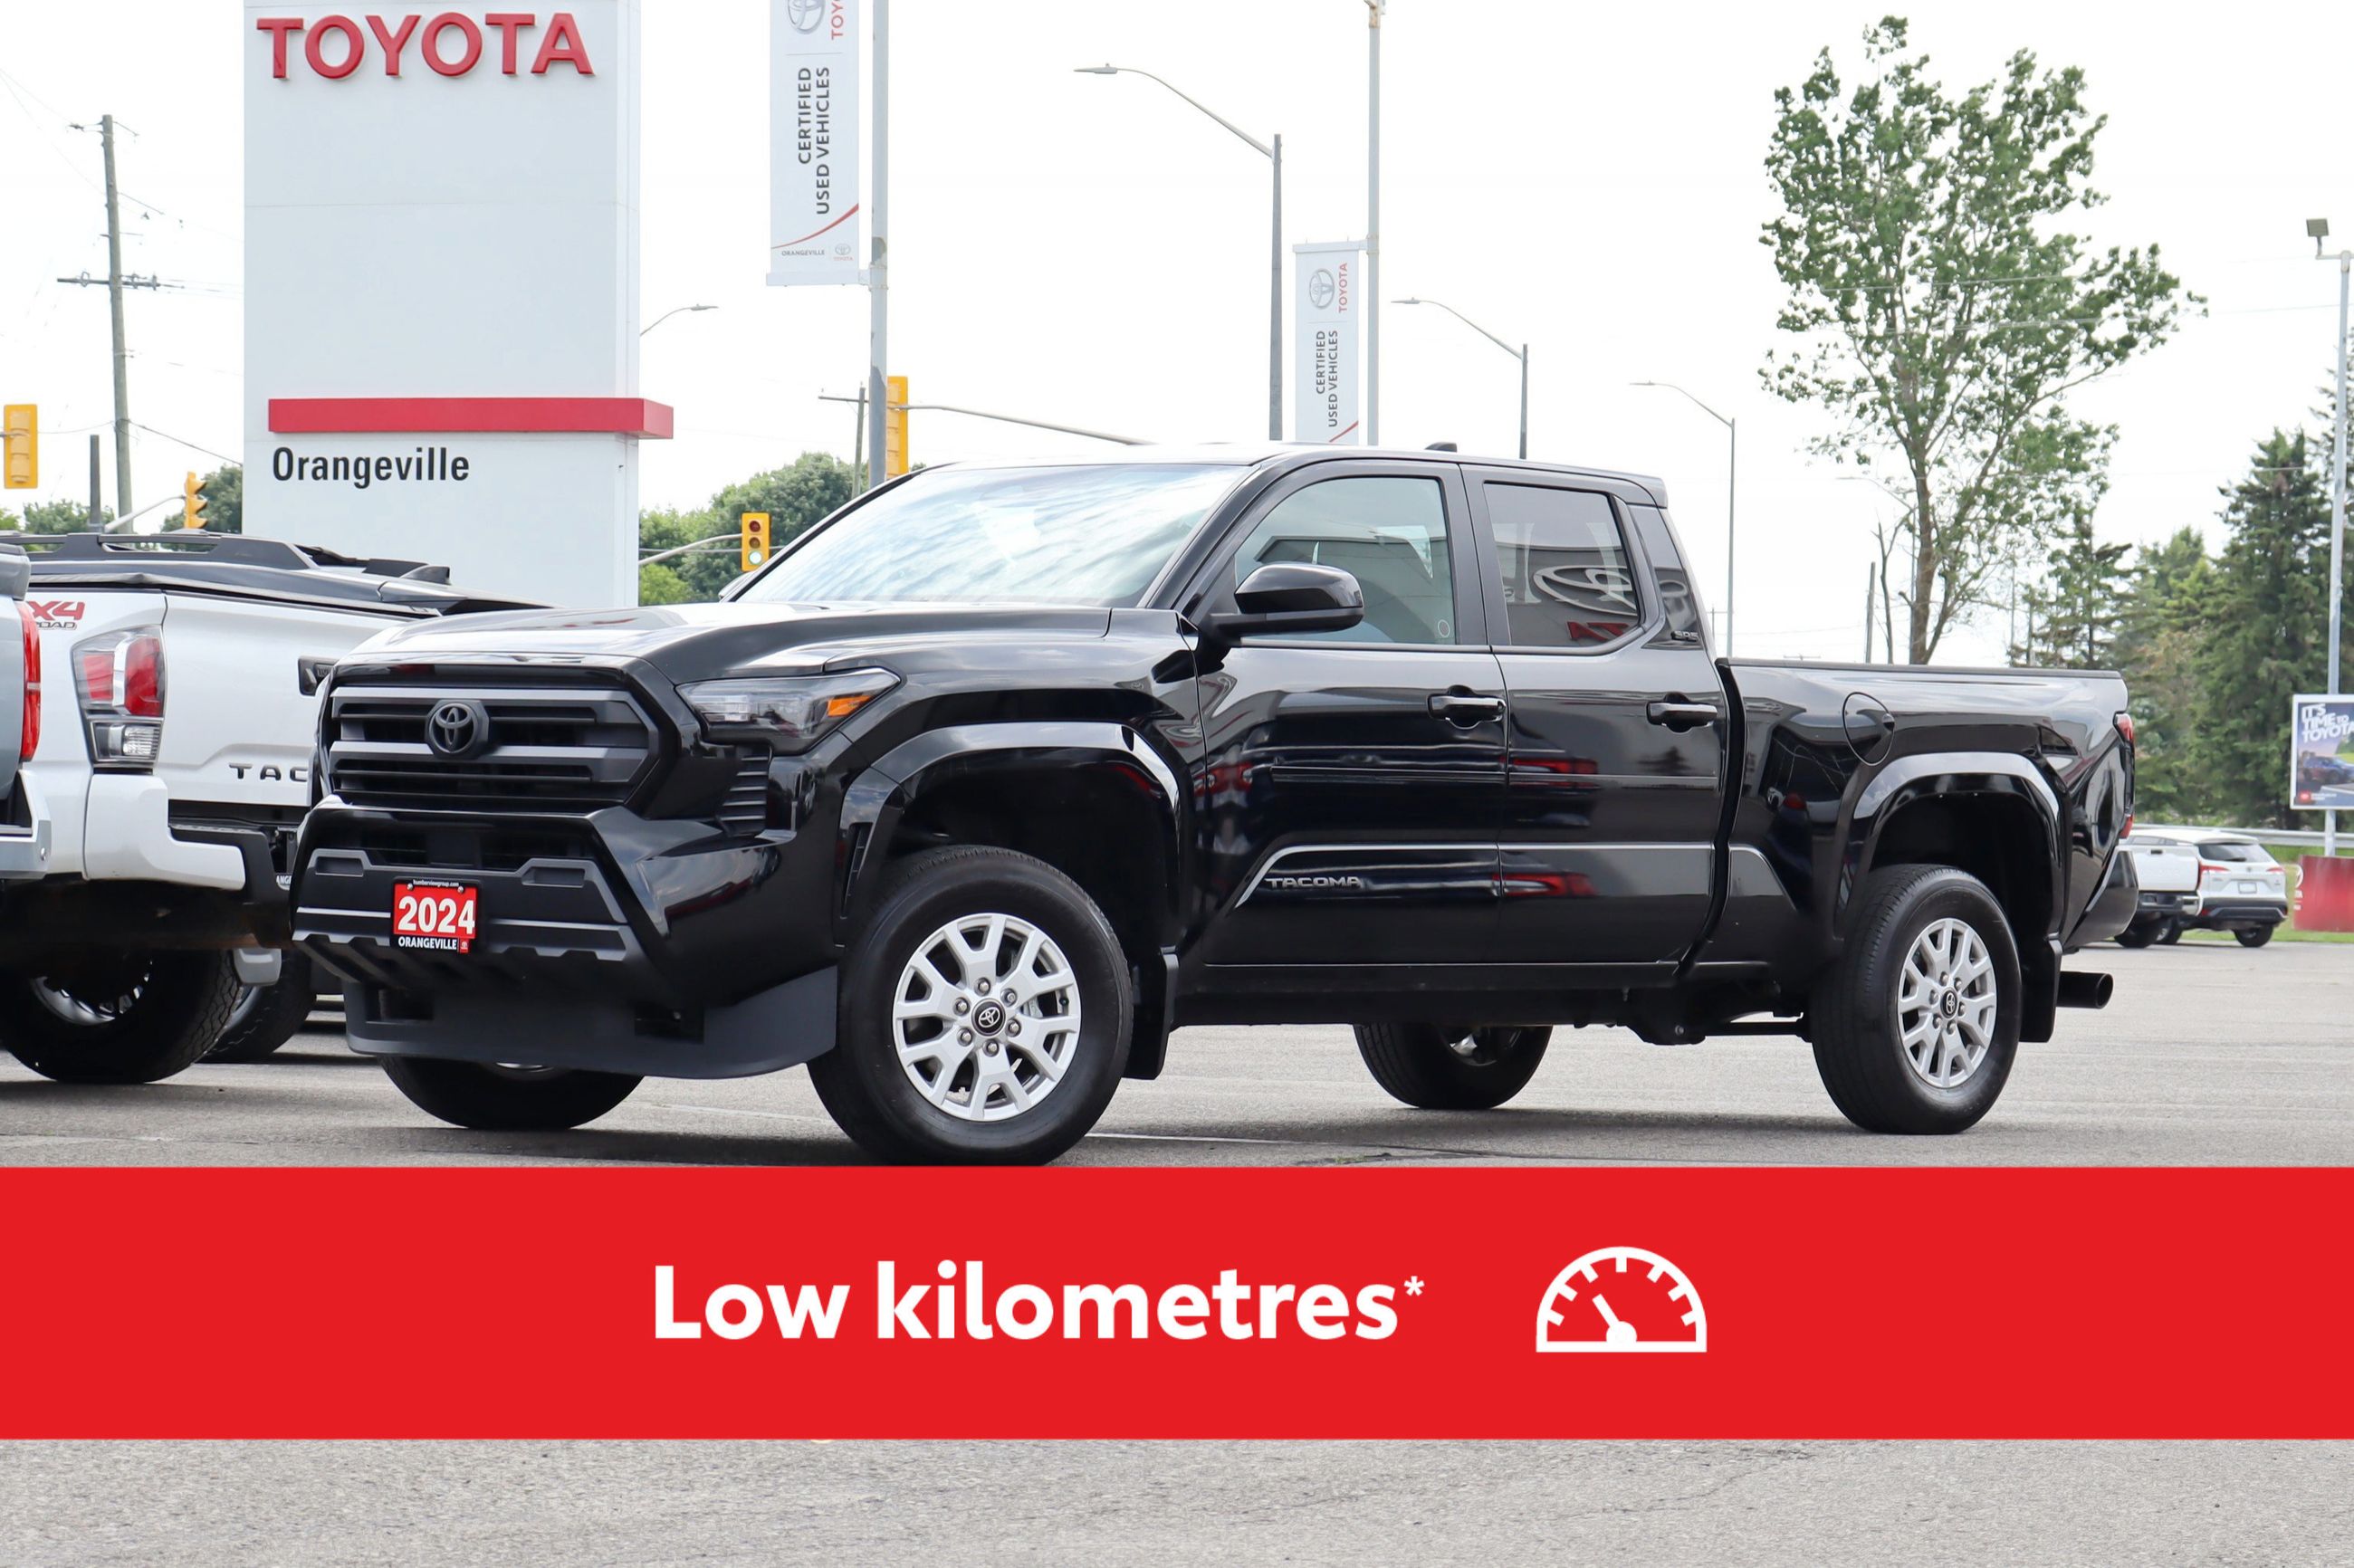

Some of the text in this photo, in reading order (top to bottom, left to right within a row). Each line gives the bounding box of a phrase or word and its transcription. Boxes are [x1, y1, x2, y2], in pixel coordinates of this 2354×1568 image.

[830, 0, 844, 41] TOY
[257, 12, 595, 81] TOYOTA
[798, 67, 812, 165] CERTIFIED
[816, 67, 830, 215] USED VEHICLES
[1338, 263, 1348, 313] TOYOTA
[1316, 330, 1325, 395] CERTIFIED
[1328, 330, 1338, 427] USED VEHICLES
[273, 446, 470, 490] Orangeville
[2302, 712, 2336, 731] TIME
[1265, 875, 1364, 888] TACOMA
[397, 895, 475, 935] 2024
[398, 935, 457, 951] ORANGEVILLE
